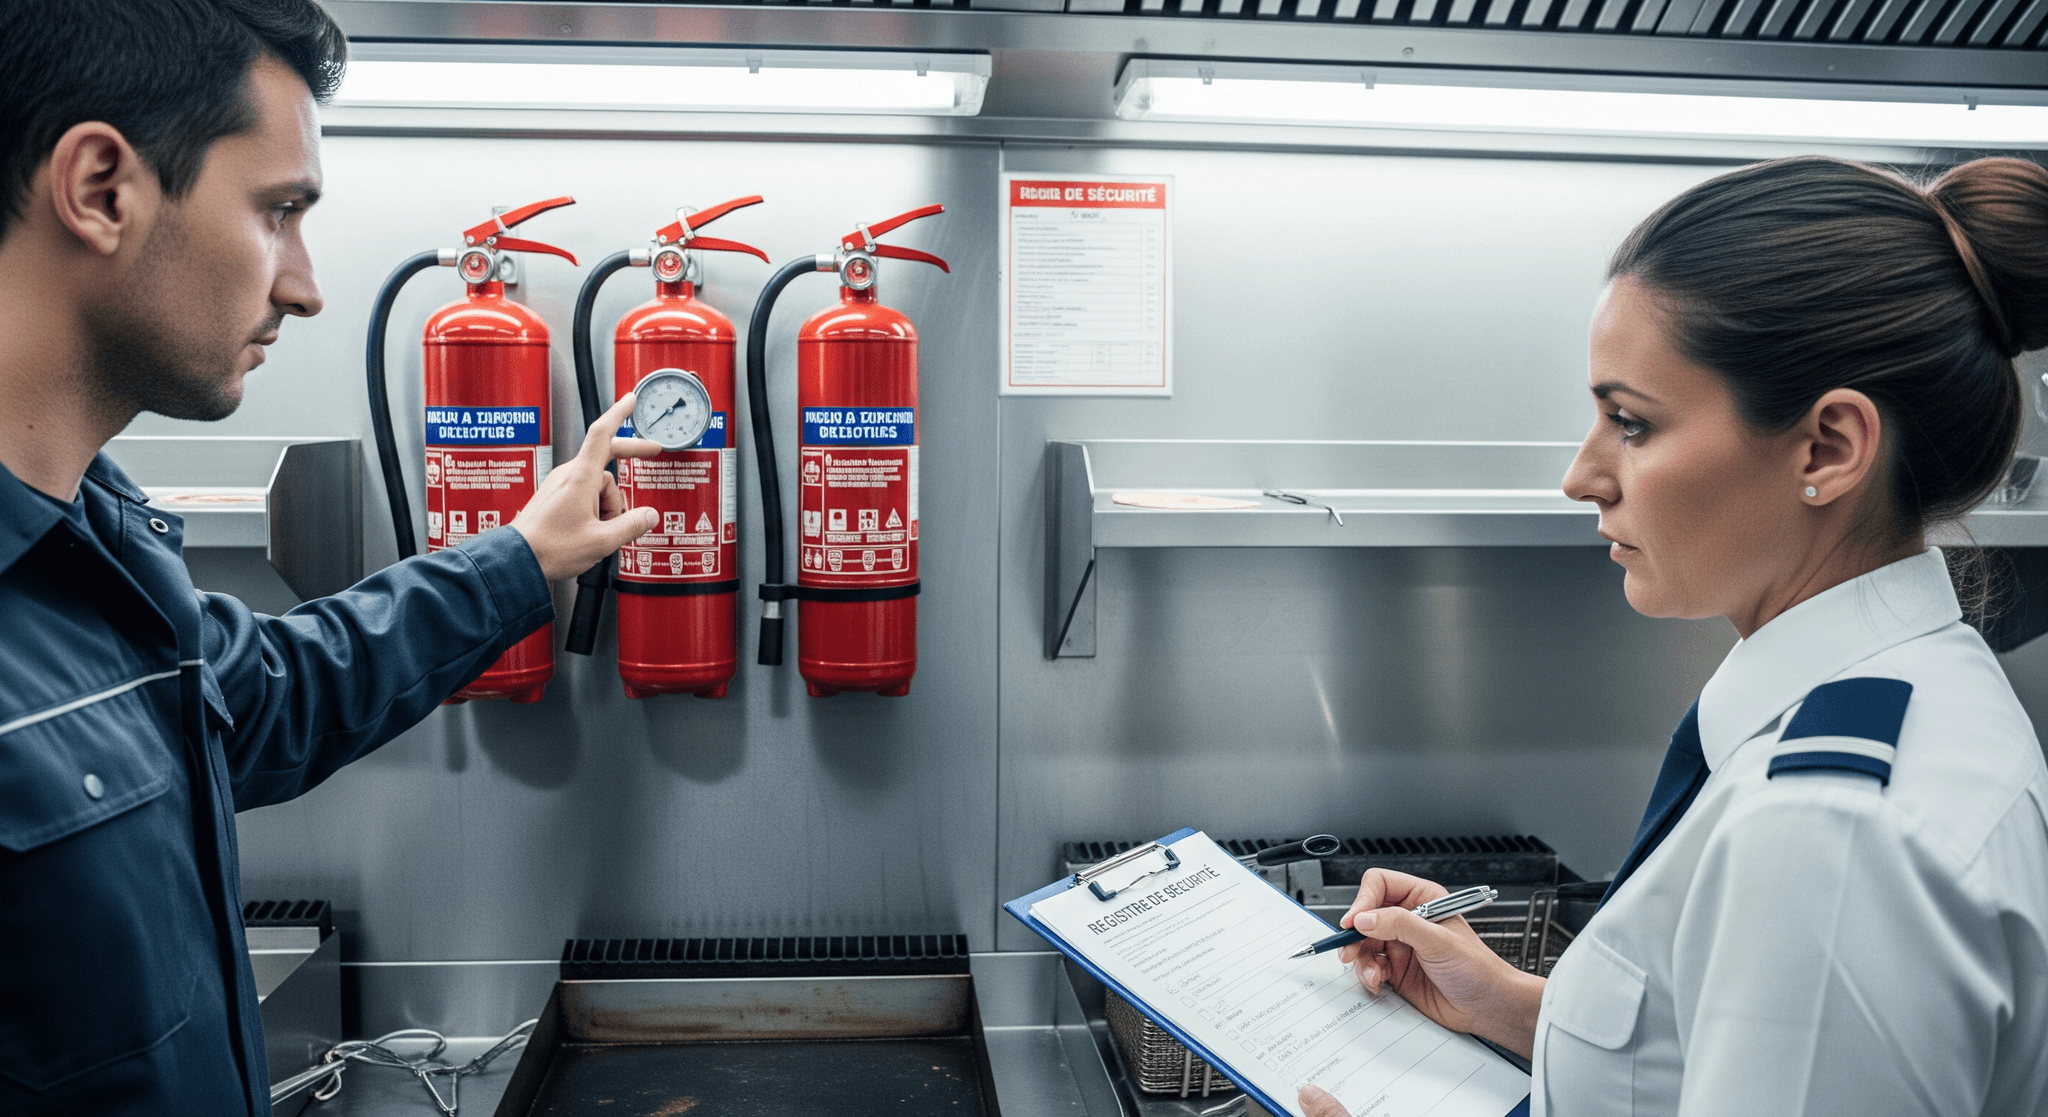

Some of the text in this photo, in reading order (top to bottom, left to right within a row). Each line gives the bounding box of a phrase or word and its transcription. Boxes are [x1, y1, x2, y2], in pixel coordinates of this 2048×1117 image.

[1064, 187, 1084, 201] DE
[1087, 186, 1156, 202] SÉCURITÉ
[1146, 891, 1169, 906] DE
